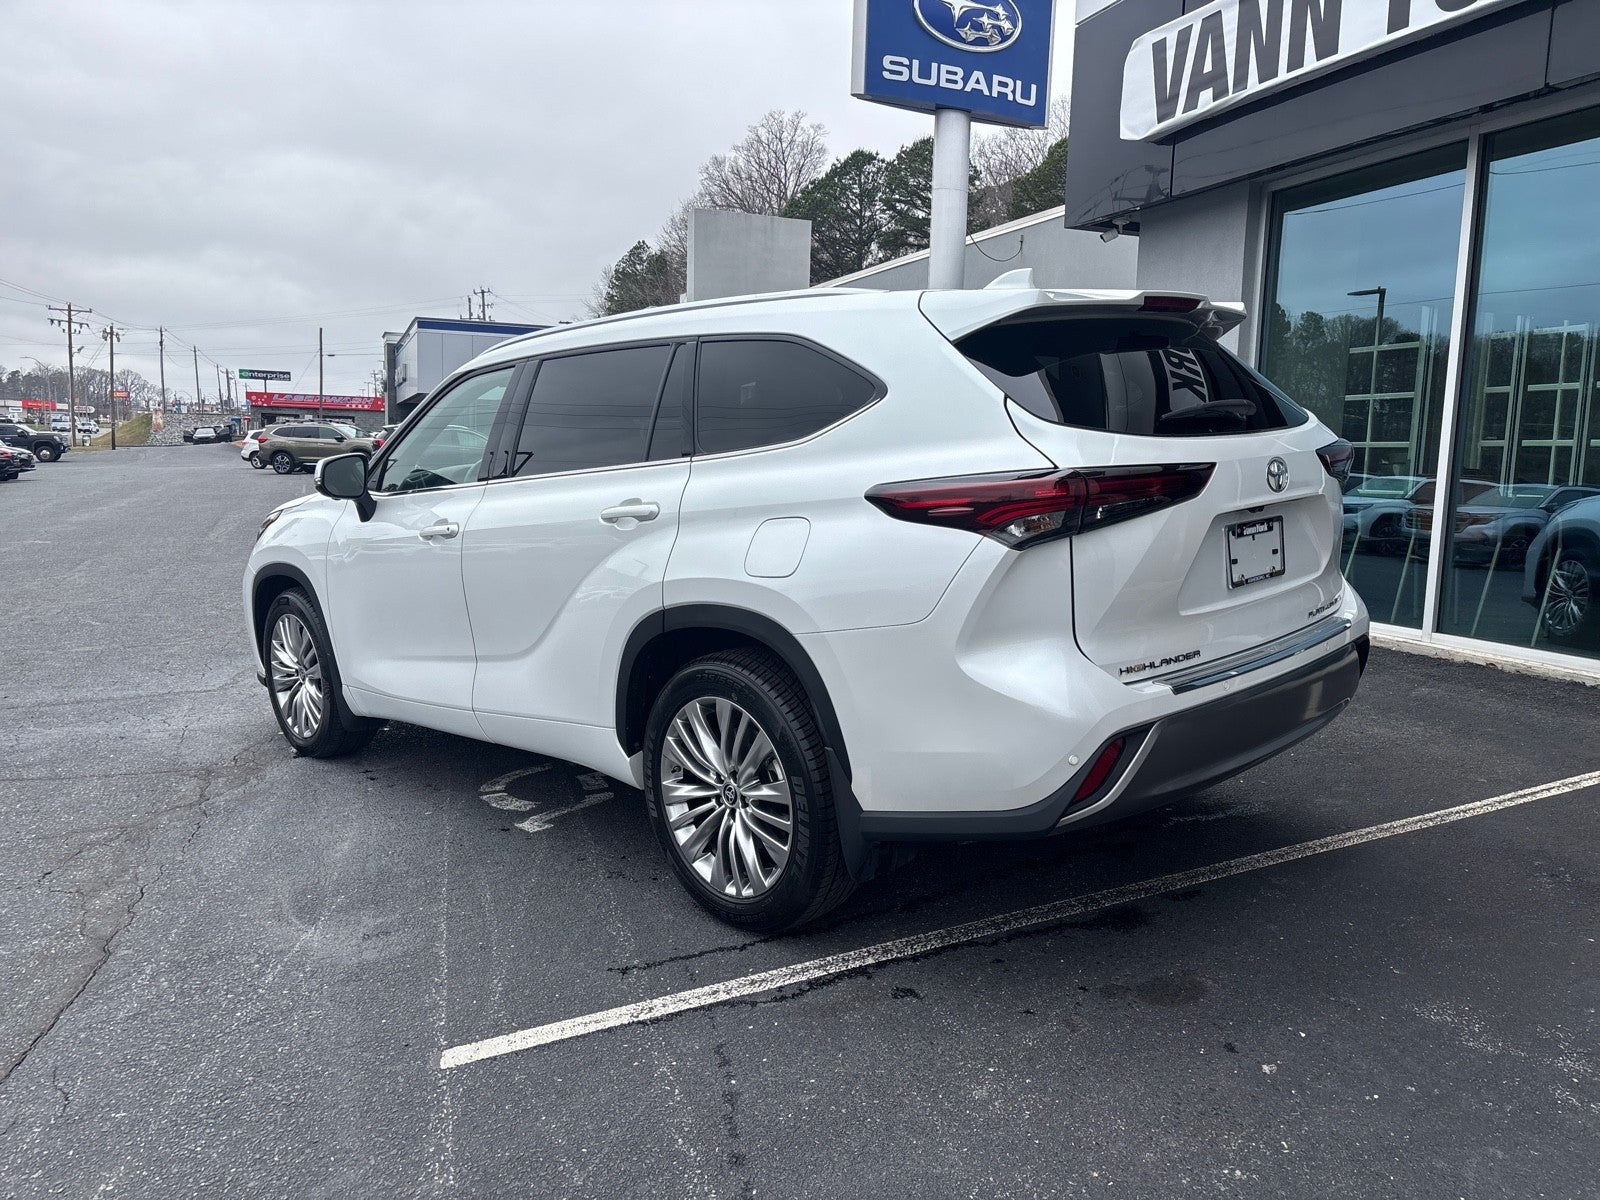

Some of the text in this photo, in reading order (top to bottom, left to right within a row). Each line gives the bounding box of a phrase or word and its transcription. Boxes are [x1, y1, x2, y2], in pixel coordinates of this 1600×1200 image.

[882, 54, 1037, 107] SUBARU
[1152, 0, 1342, 125] VANN
[240, 370, 290, 379] enterprise
[1118, 650, 1201, 675] HIGHLANDER
